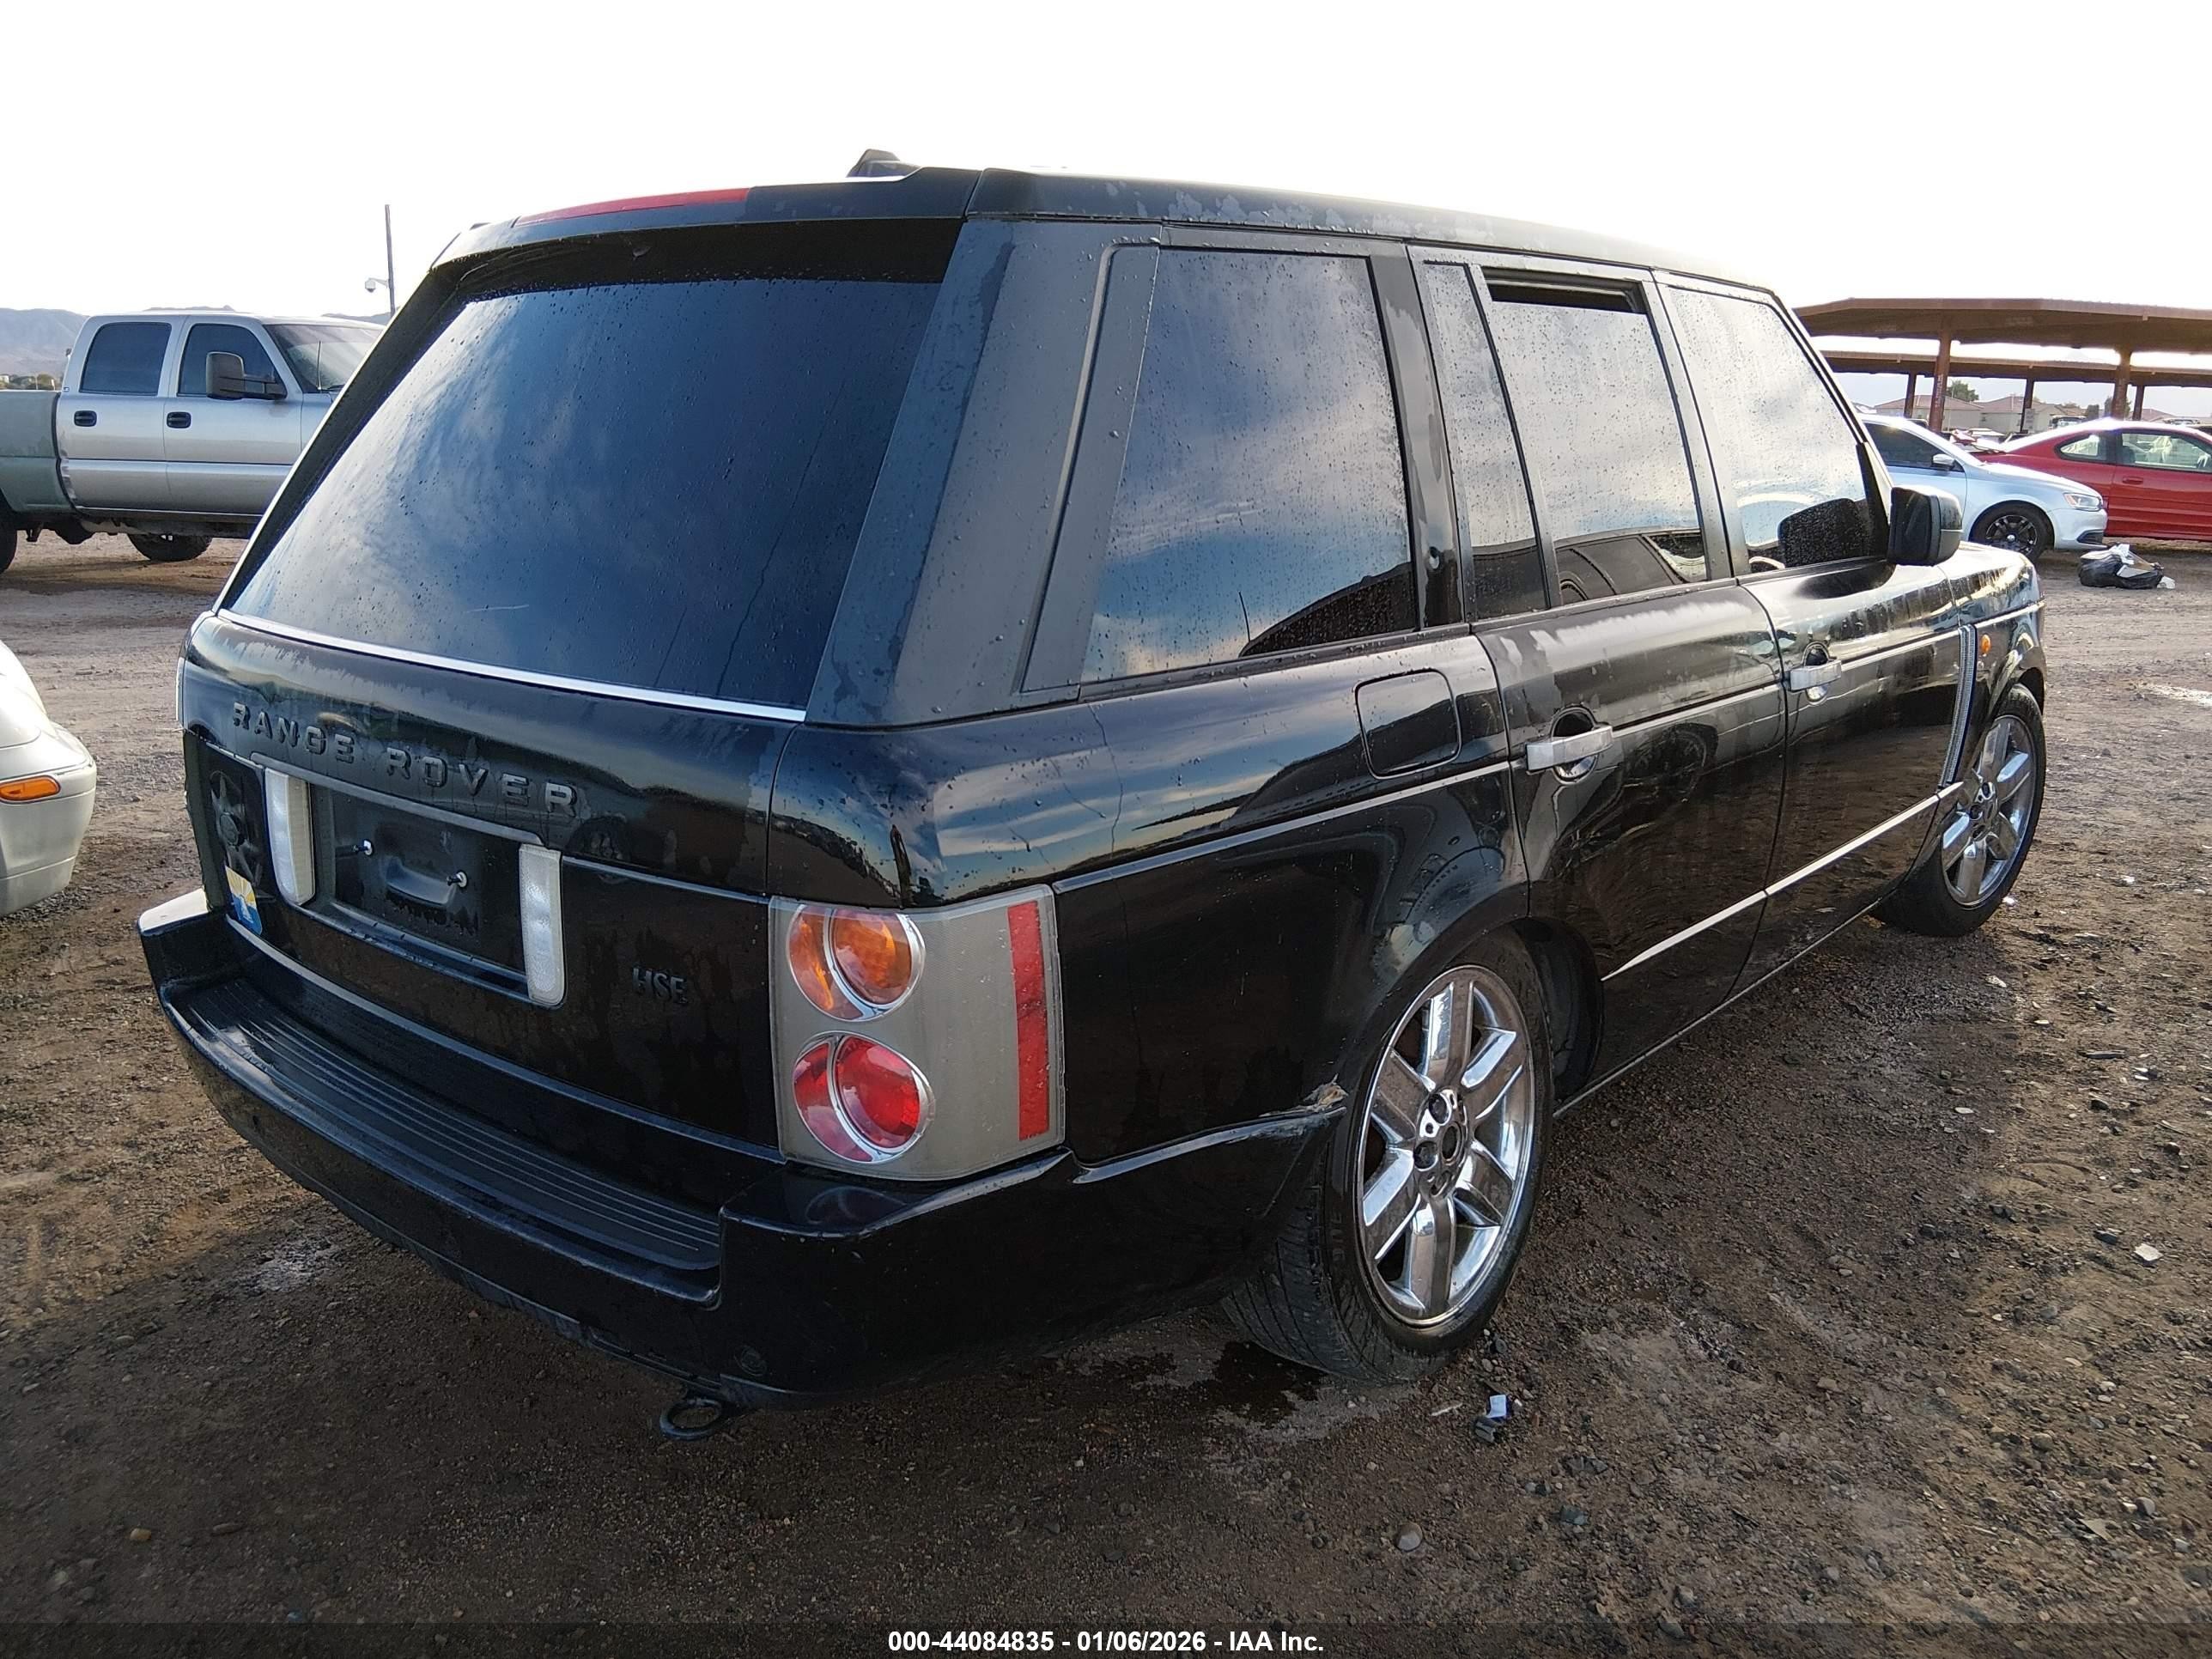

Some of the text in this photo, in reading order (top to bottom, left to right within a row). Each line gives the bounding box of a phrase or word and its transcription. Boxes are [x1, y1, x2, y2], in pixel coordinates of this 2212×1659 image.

[233, 701, 578, 817] RANGE ROVER
[632, 967, 688, 1004] HSE
